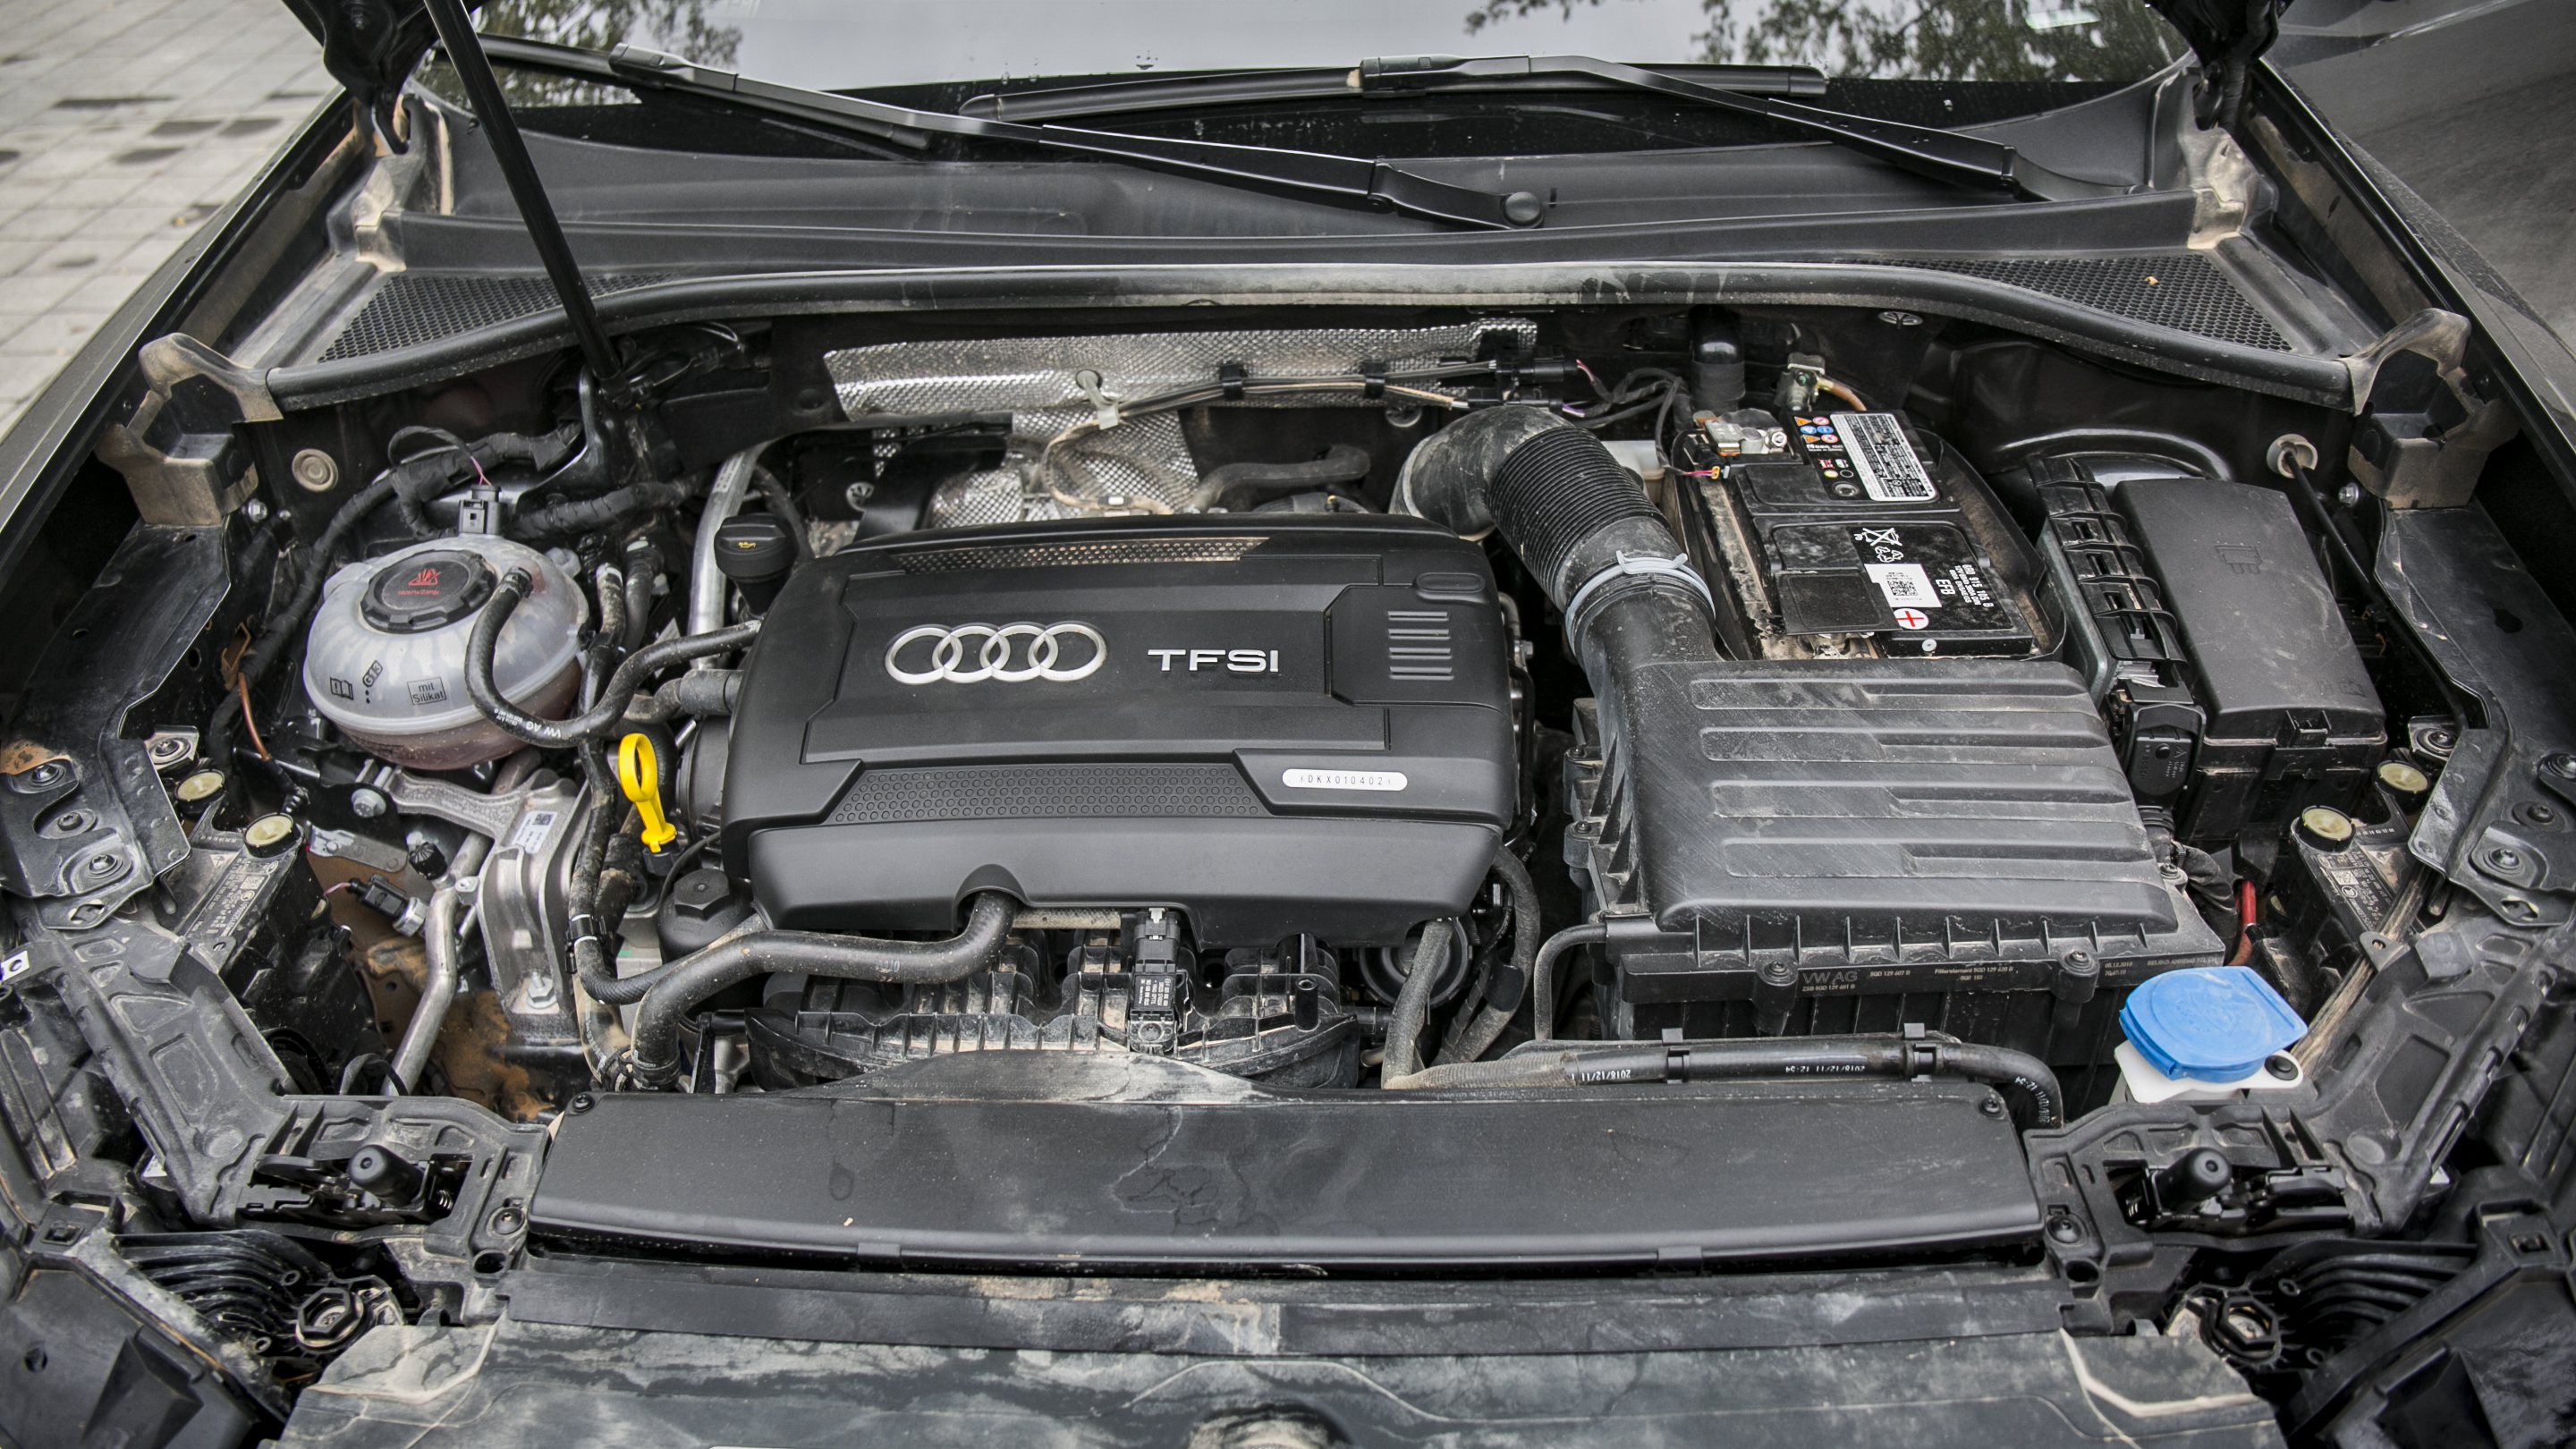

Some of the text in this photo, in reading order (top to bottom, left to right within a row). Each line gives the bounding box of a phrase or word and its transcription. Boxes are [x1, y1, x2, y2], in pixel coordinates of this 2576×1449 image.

[1935, 580, 1955, 594] EFB
[1147, 648, 1280, 673] TFSI
[362, 662, 382, 686] G13
[419, 682, 435, 692] mit
[412, 691, 445, 703] Silikat
[525, 721, 562, 738] VW AG
[1802, 970, 1858, 984] VW AG
[1581, 1069, 1631, 1081] 2018/12/11
[1816, 1064, 1866, 1072] 2018/12/11
